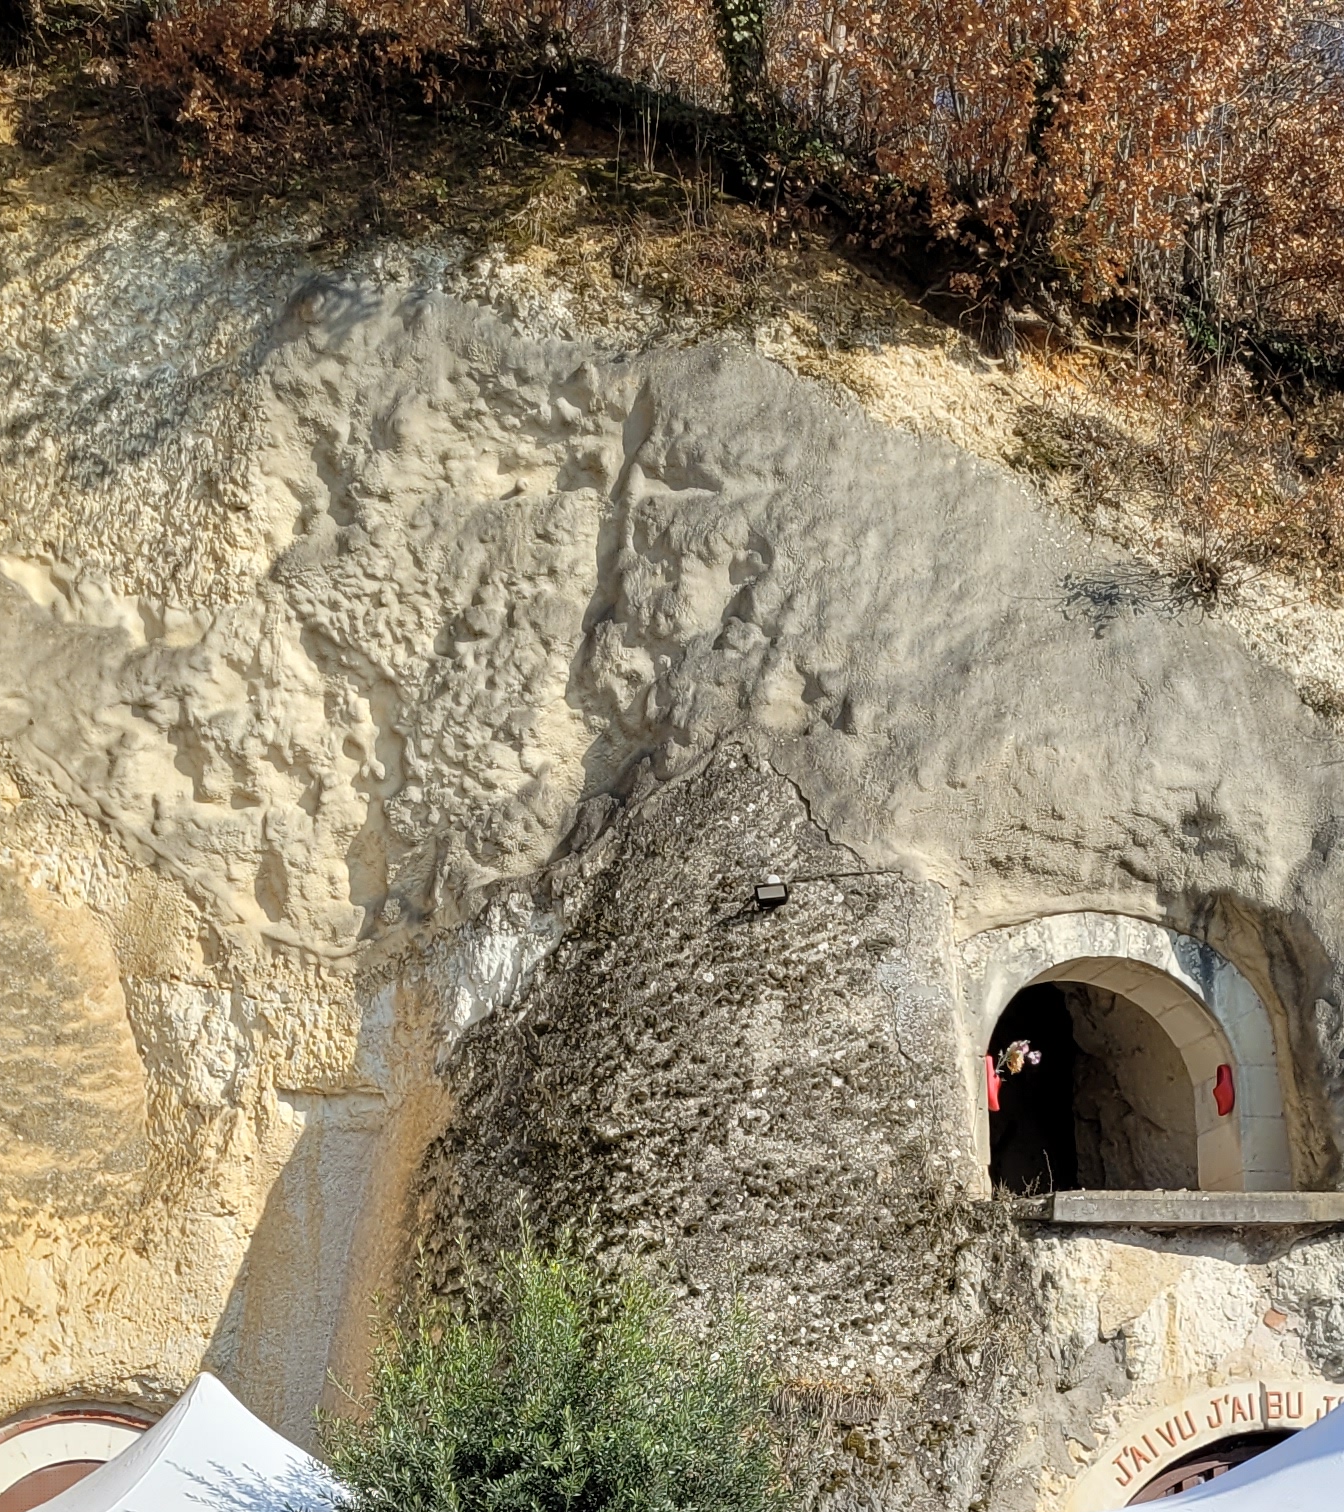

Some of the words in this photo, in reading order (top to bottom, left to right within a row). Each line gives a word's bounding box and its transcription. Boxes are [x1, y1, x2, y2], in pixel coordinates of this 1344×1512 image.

[1112, 1434, 1160, 1487] J'AI
[1156, 1410, 1198, 1448] VU
[1206, 1393, 1255, 1428] J'AI
[1266, 1391, 1304, 1419] BU
